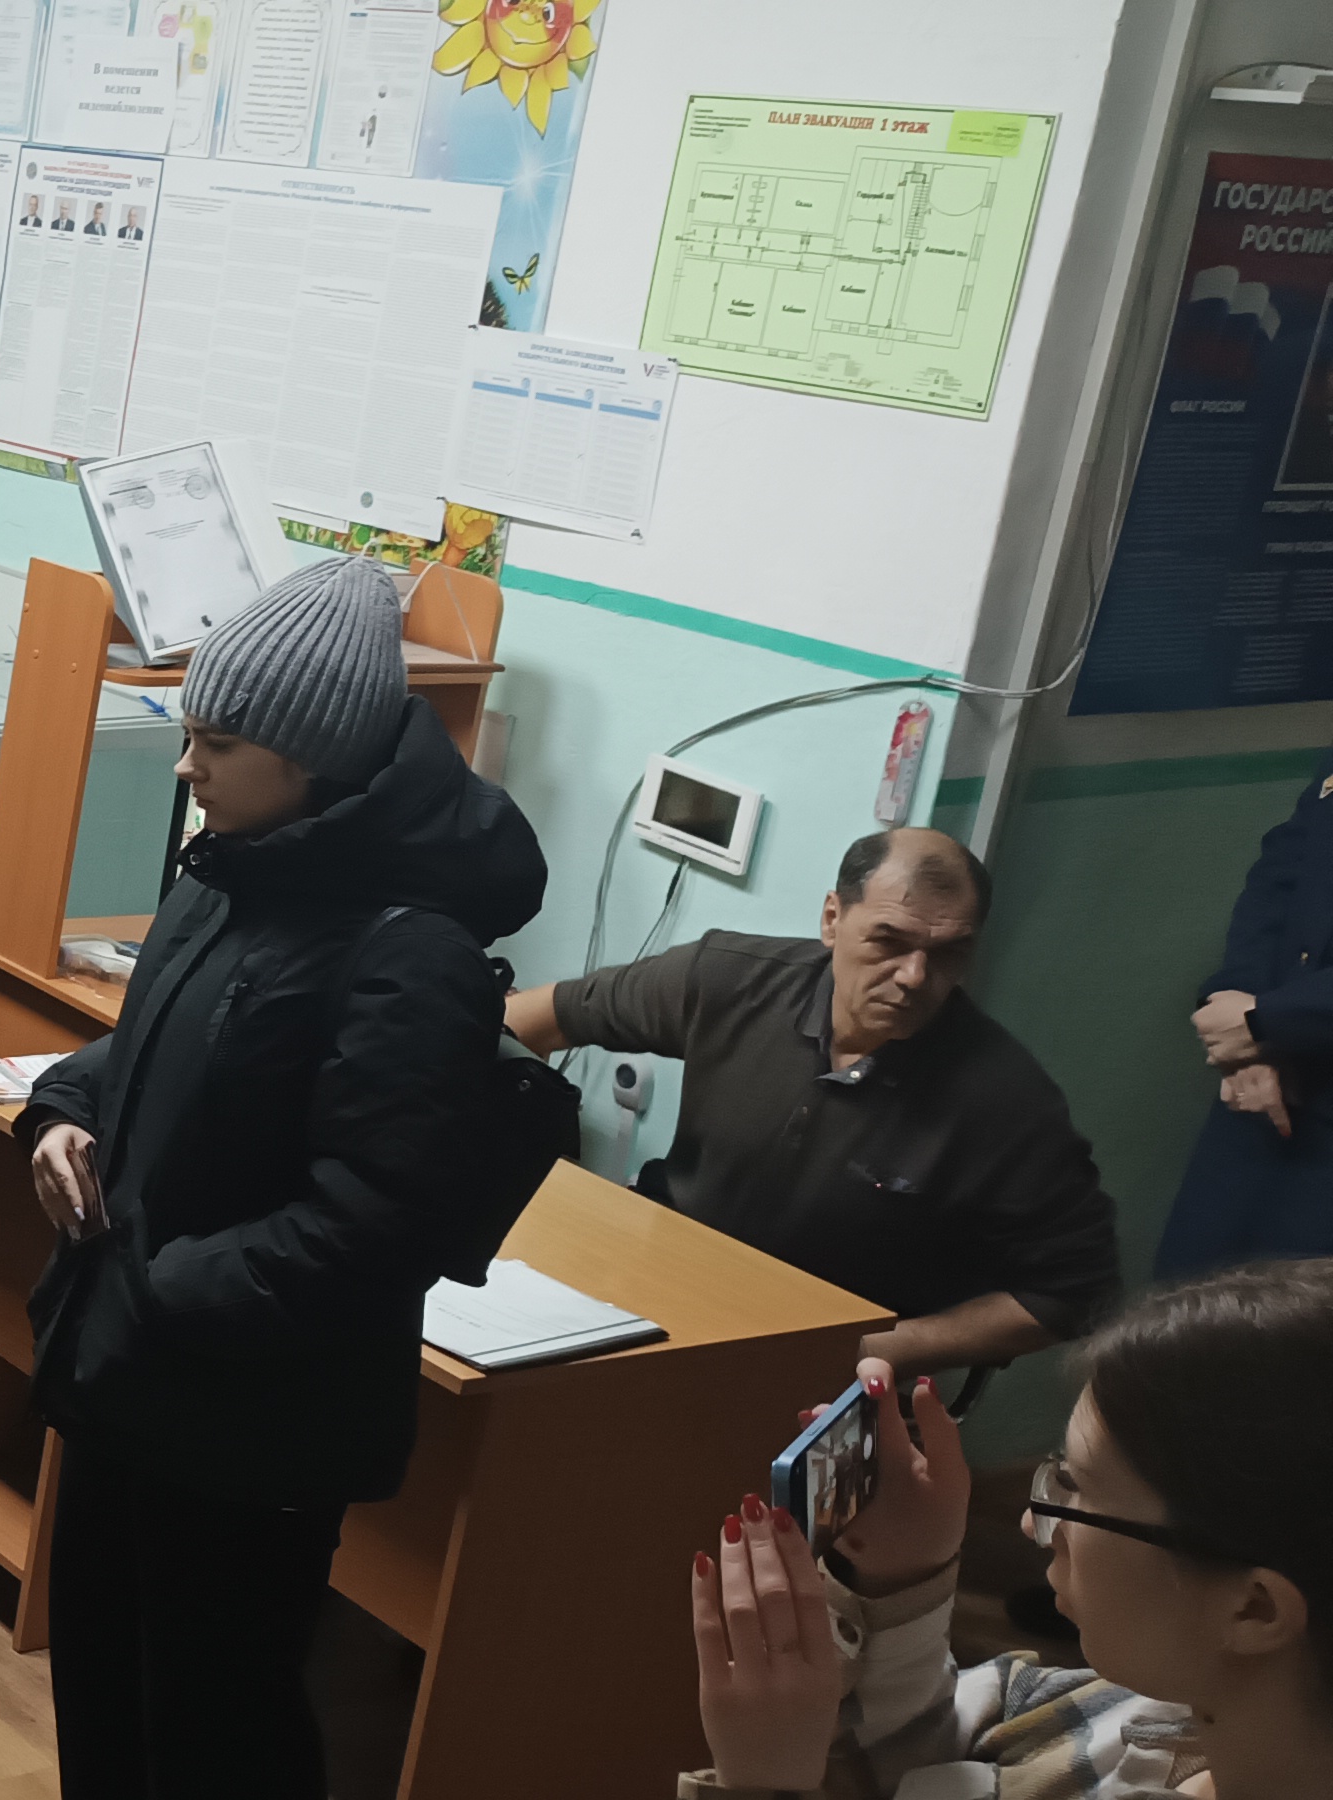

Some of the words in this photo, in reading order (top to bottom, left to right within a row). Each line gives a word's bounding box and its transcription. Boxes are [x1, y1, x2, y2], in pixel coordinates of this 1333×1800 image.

[93, 62, 101, 75] В
[768, 111, 801, 126] ПЛАН
[803, 114, 875, 130] ЭВАКУАЦИИ
[880, 118, 889, 131] 1
[891, 120, 930, 134] этаж
